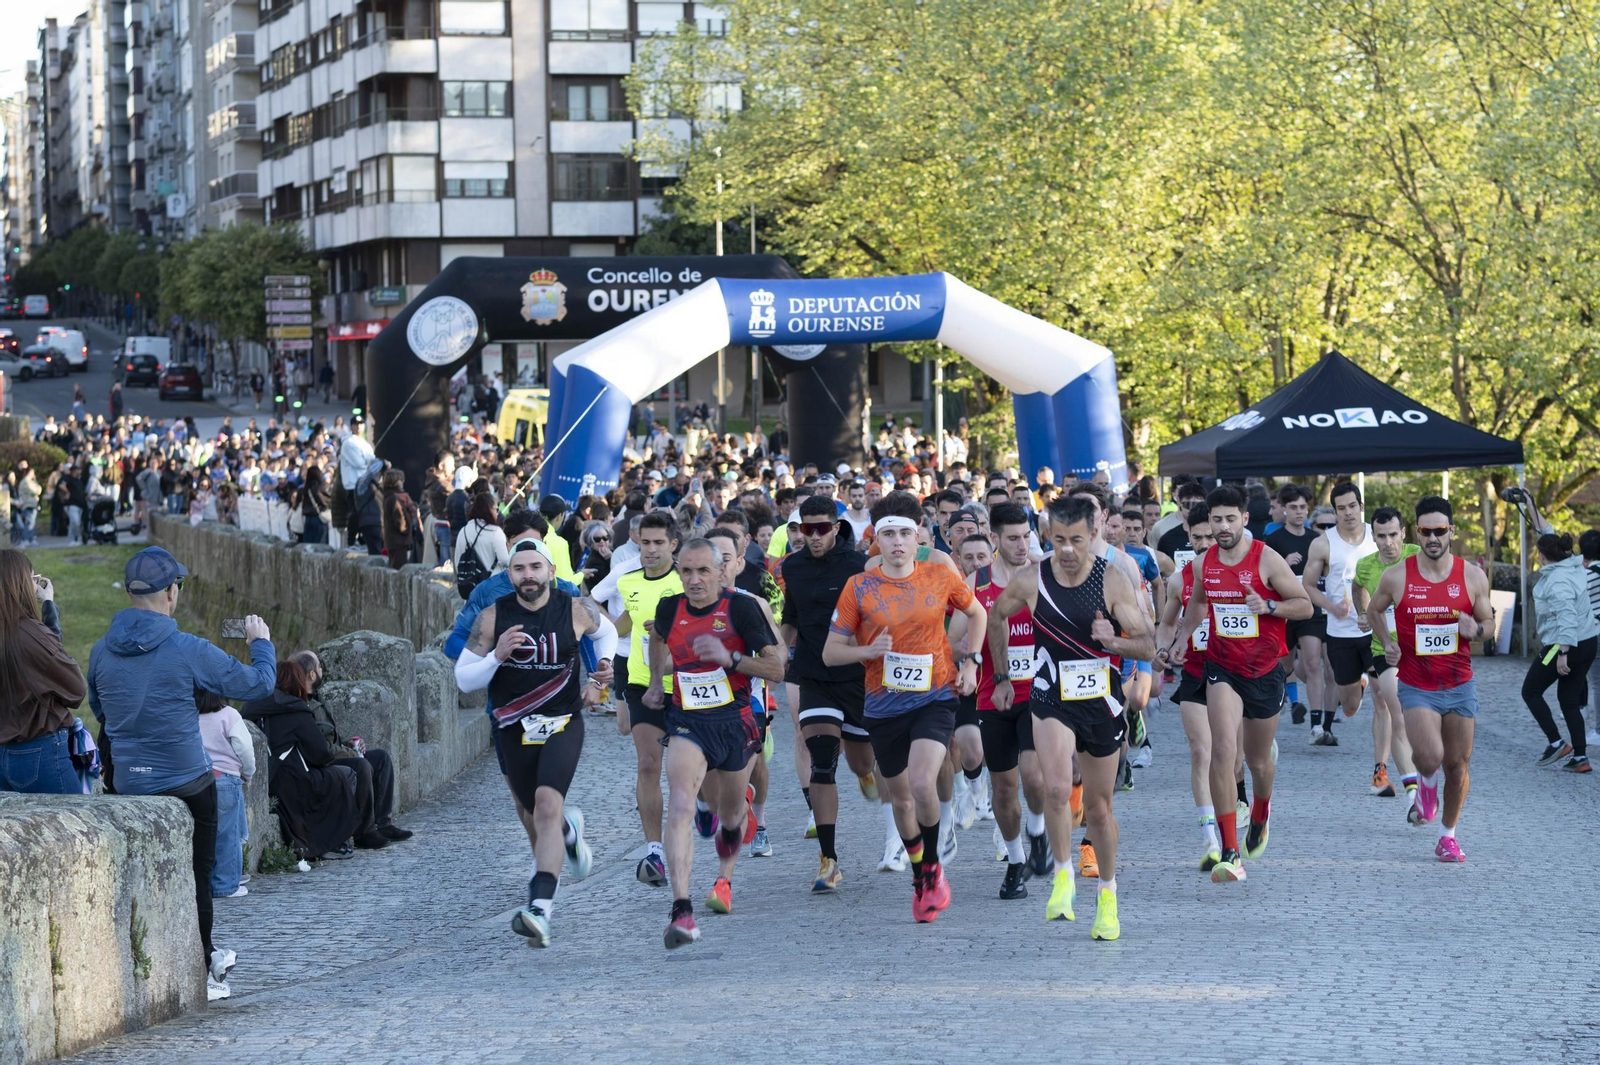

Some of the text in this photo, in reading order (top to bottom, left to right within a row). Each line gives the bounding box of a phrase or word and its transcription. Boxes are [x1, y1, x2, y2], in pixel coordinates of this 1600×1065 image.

[587, 267, 702, 284] Concello de
[788, 291, 921, 314] DEPUTACIÓN
[788, 316, 885, 333] OURENSE
[1222, 616, 1248, 628] 636
[1425, 636, 1450, 647] 506
[893, 666, 923, 681] 672
[1077, 674, 1096, 689] 25
[691, 684, 719, 698] 421
